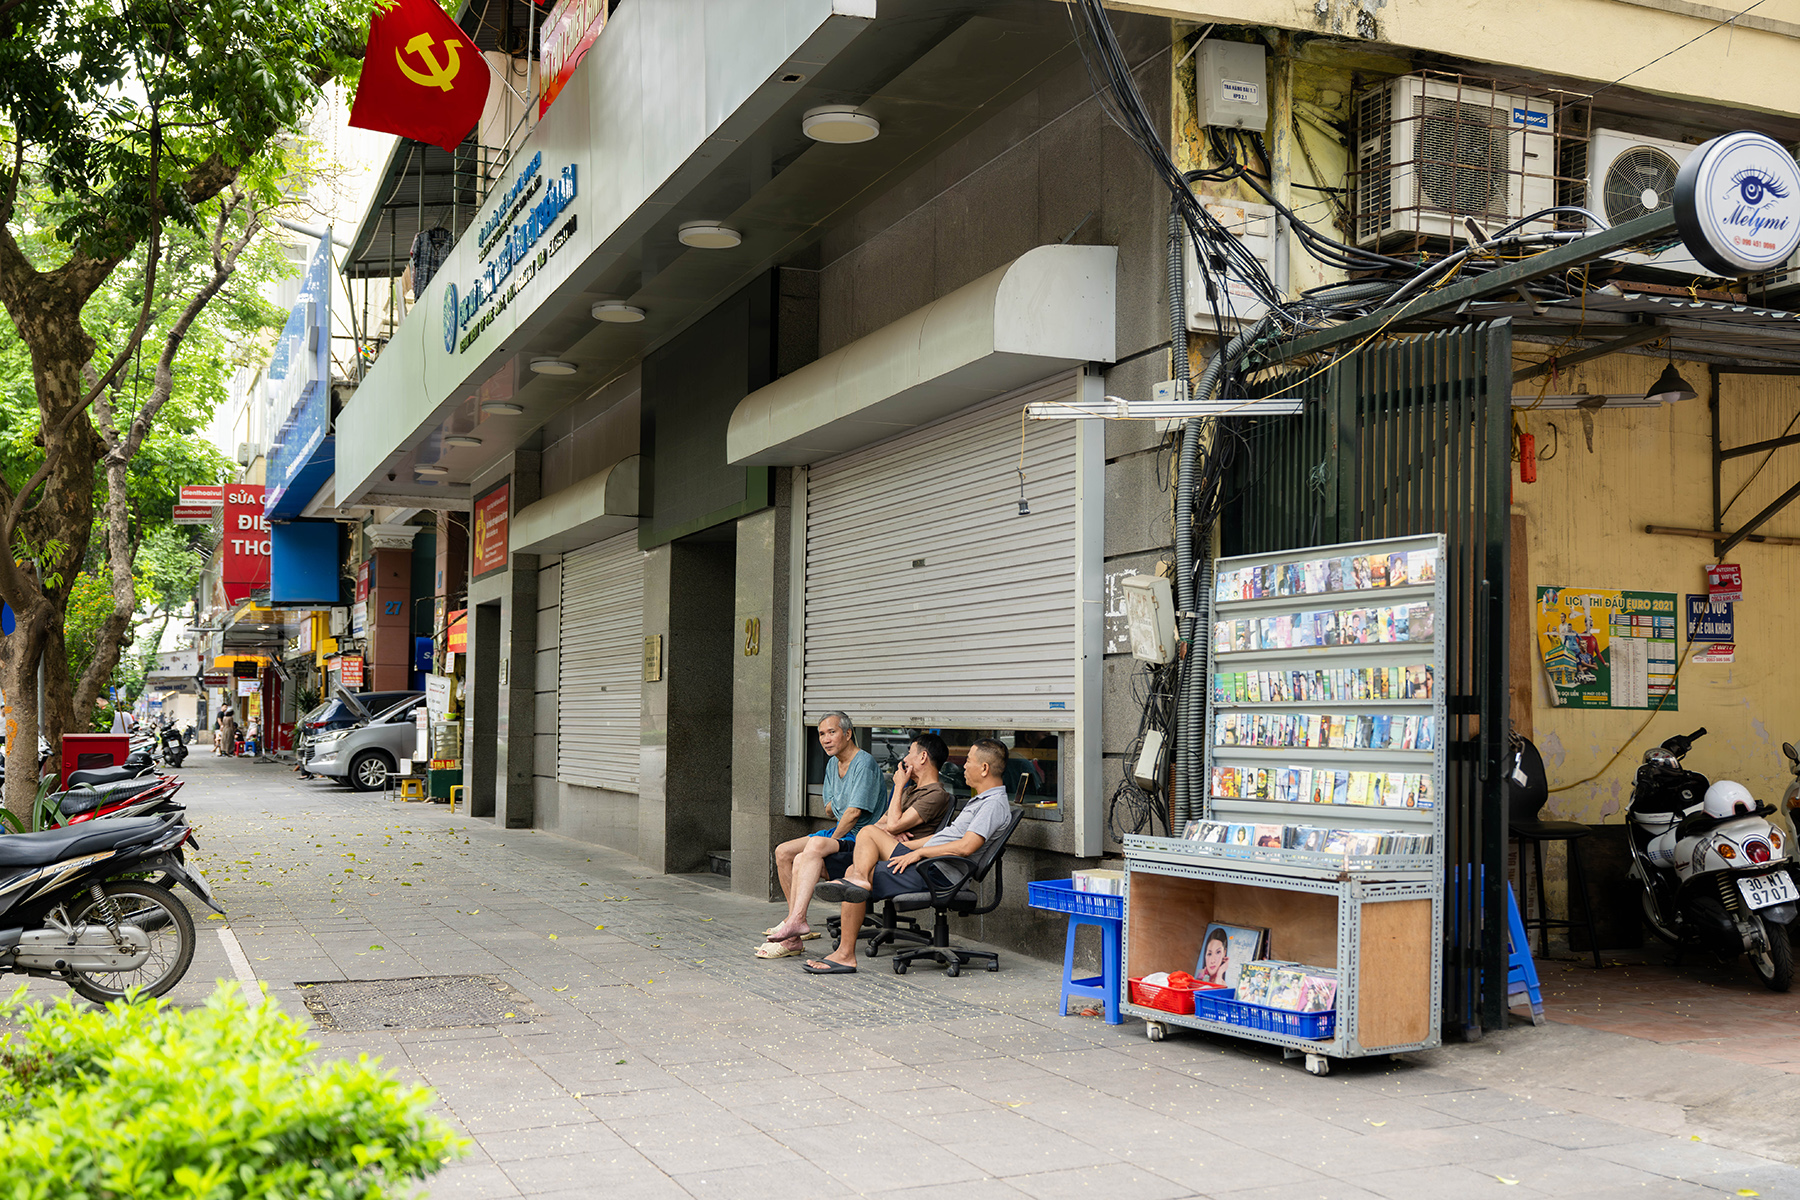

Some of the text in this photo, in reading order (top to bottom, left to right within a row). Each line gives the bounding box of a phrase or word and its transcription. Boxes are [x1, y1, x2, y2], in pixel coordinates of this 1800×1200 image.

[1723, 203, 1789, 238] Melymi
[182, 489, 222, 497] dienthoaivui
[228, 489, 256, 505] SỬA
[174, 508, 212, 516] dienthoaivui
[238, 511, 271, 534] ĐIỆ
[231, 539, 272, 556] THO
[1732, 573, 1741, 585] 6
[385, 601, 402, 615] 27
[1565, 594, 1674, 612] LỊC THI ĐẤU EURO 2021
[1693, 601, 1727, 617] KHU VỰC
[1704, 617, 1715, 634] CỦA
[1715, 620, 1732, 634] KHÁCH
[1752, 885, 1788, 905] 9707
[1248, 964, 1271, 974] DANCE
